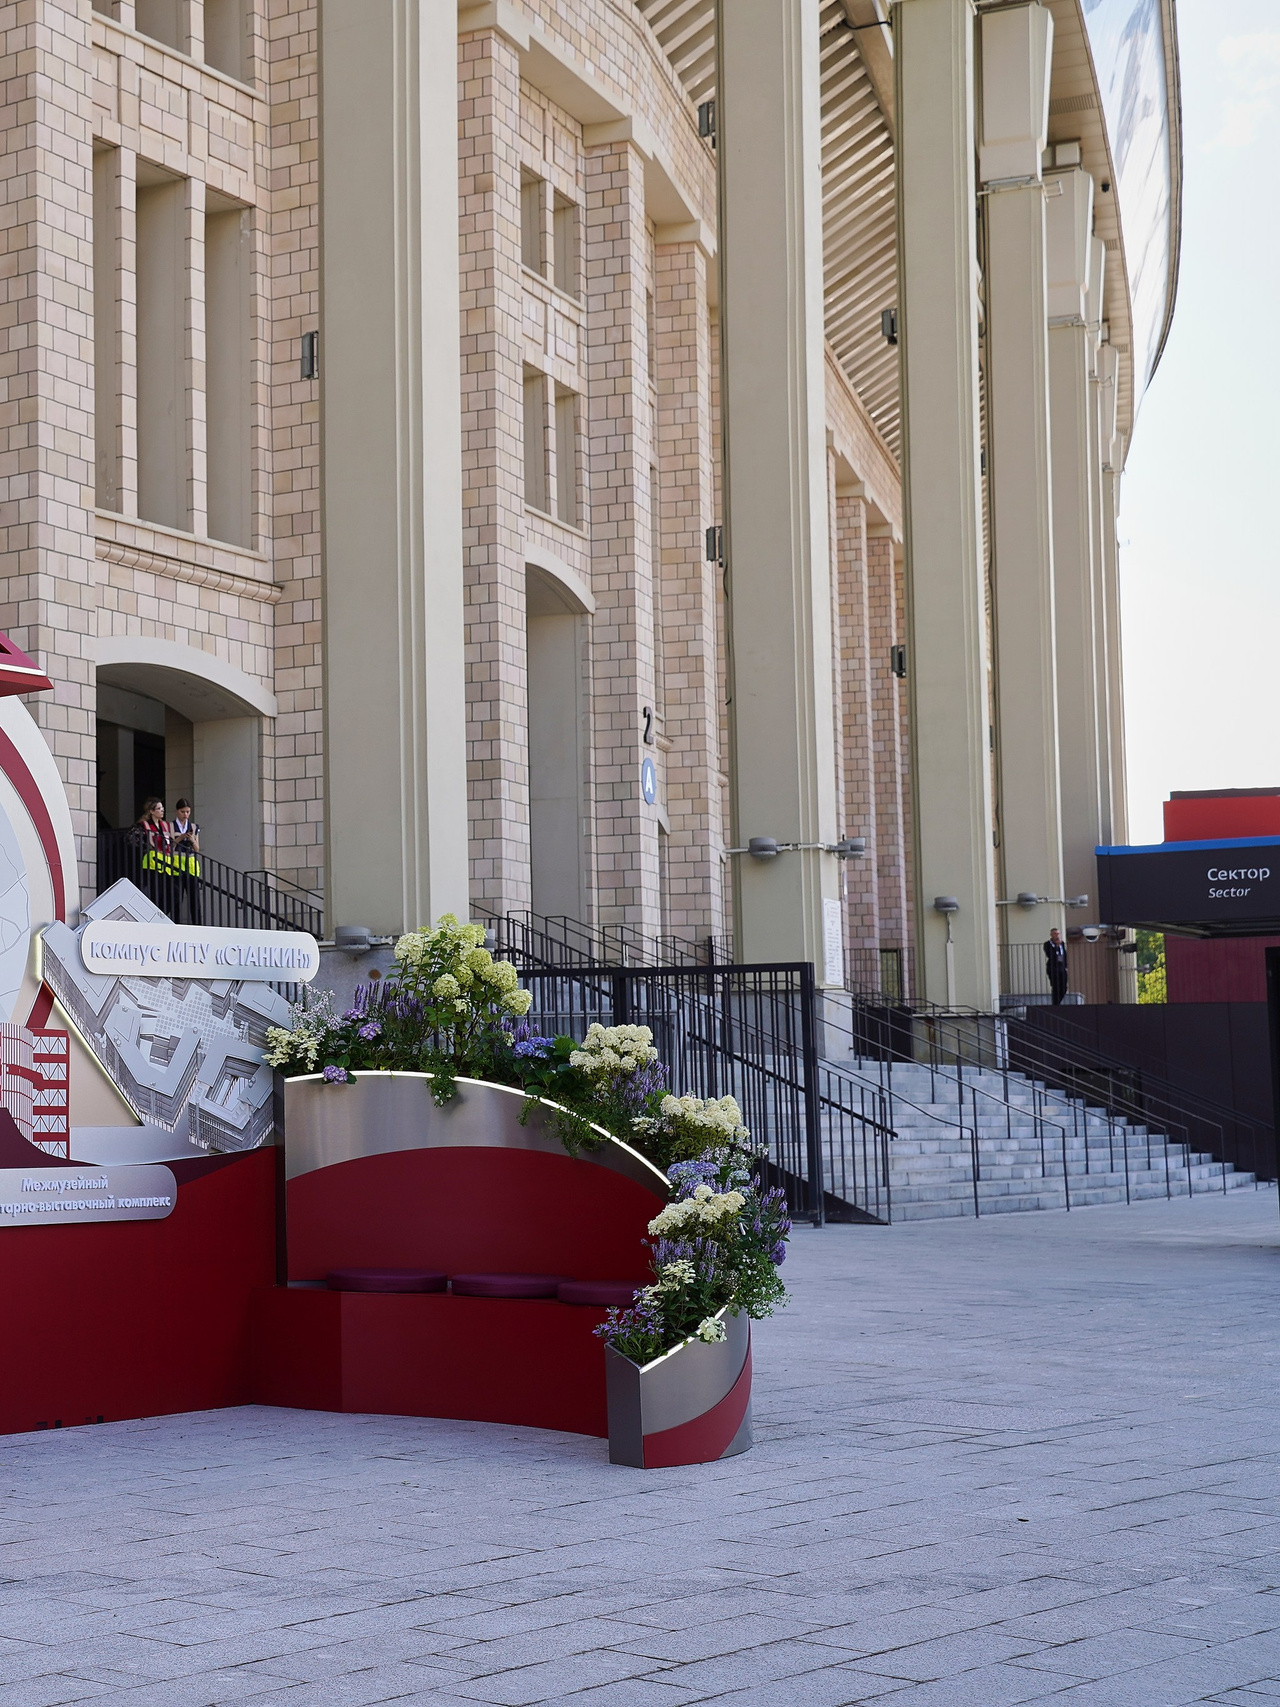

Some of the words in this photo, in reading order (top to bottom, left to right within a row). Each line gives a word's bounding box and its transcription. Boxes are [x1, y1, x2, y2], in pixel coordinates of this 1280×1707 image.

[643, 706, 654, 745] 2
[1207, 867, 1271, 881] Сектор
[1208, 887, 1251, 898] Sector
[90, 941, 161, 966] кампус
[21, 1174, 109, 1194] Межмузейный
[117, 1196, 171, 1208] комплекс
